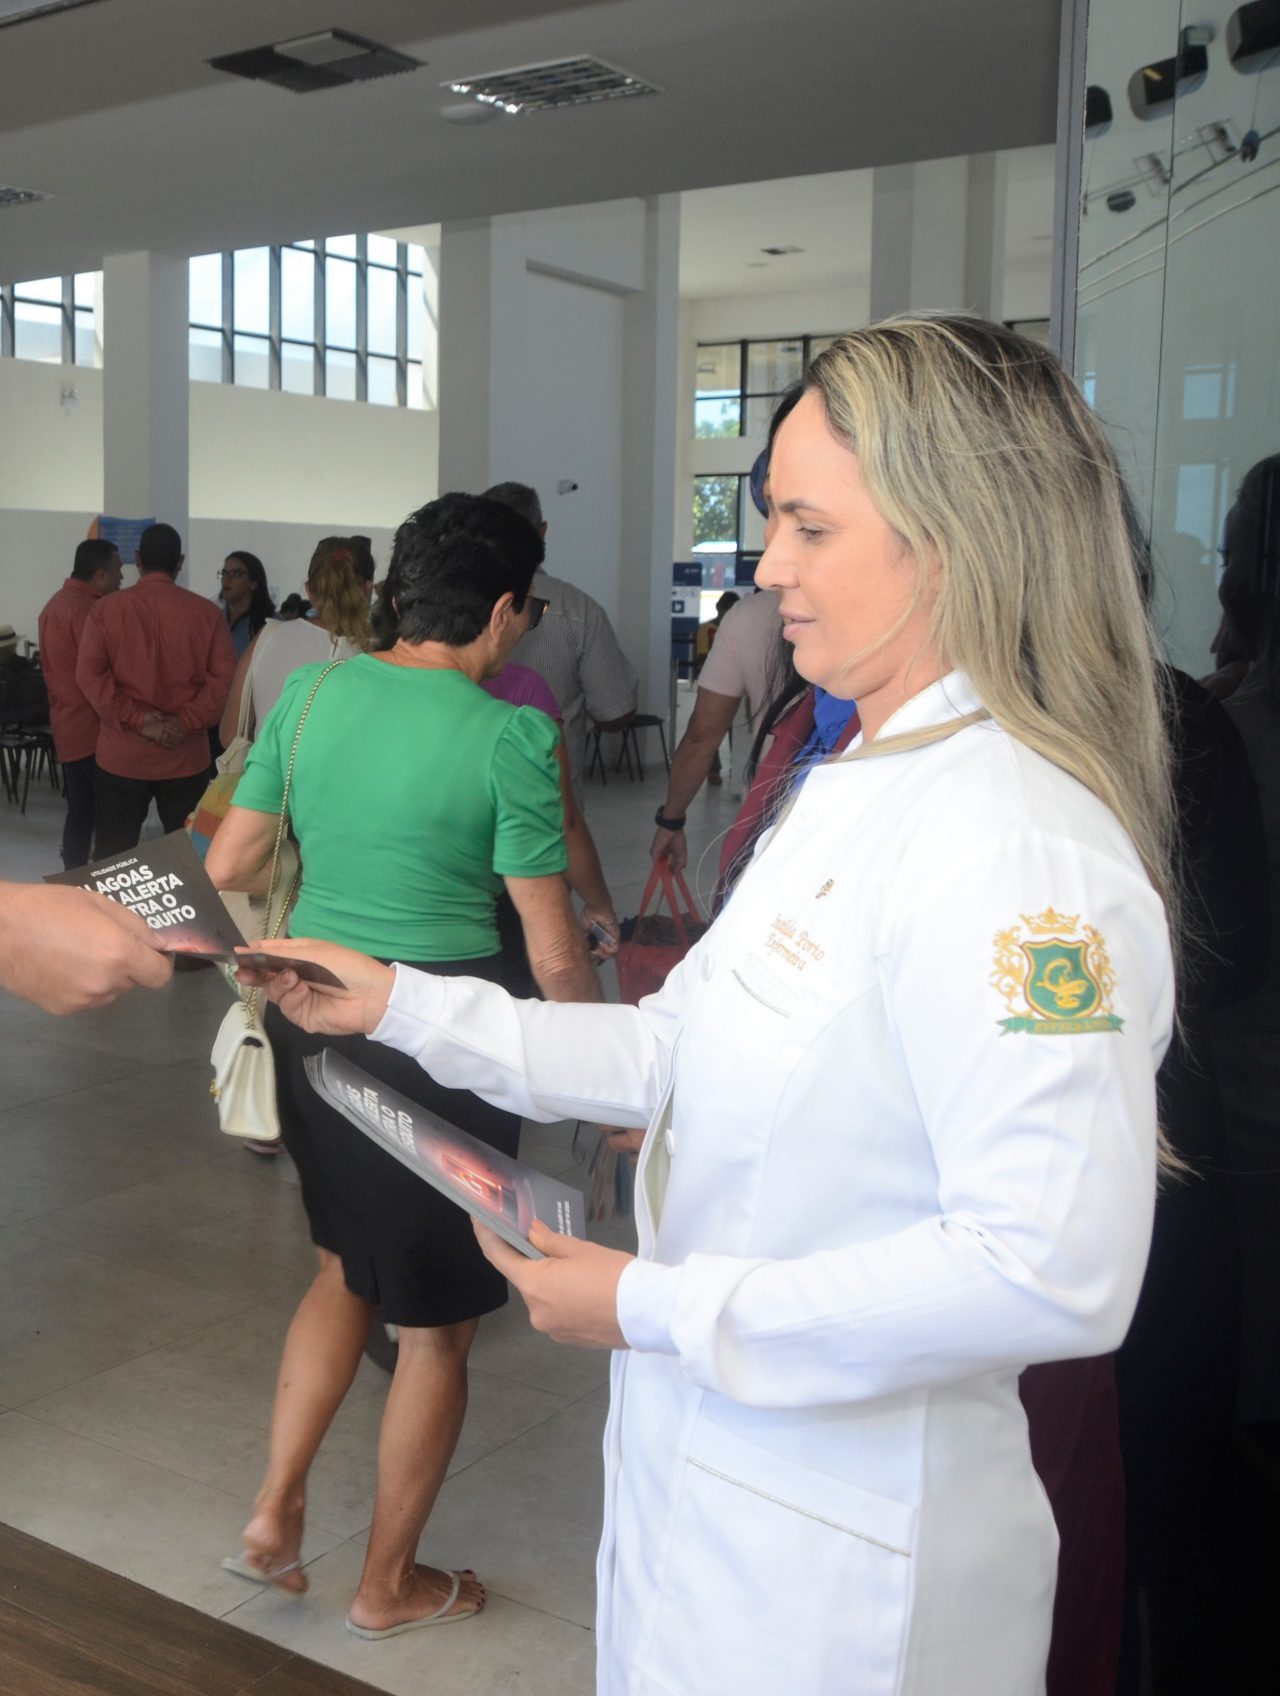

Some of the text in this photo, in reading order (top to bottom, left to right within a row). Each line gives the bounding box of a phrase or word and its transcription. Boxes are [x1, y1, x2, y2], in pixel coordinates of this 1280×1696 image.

[118, 872, 184, 906] ALERTA
[127, 898, 163, 918] TRA
[162, 893, 178, 909] O
[146, 905, 196, 929] QUITO
